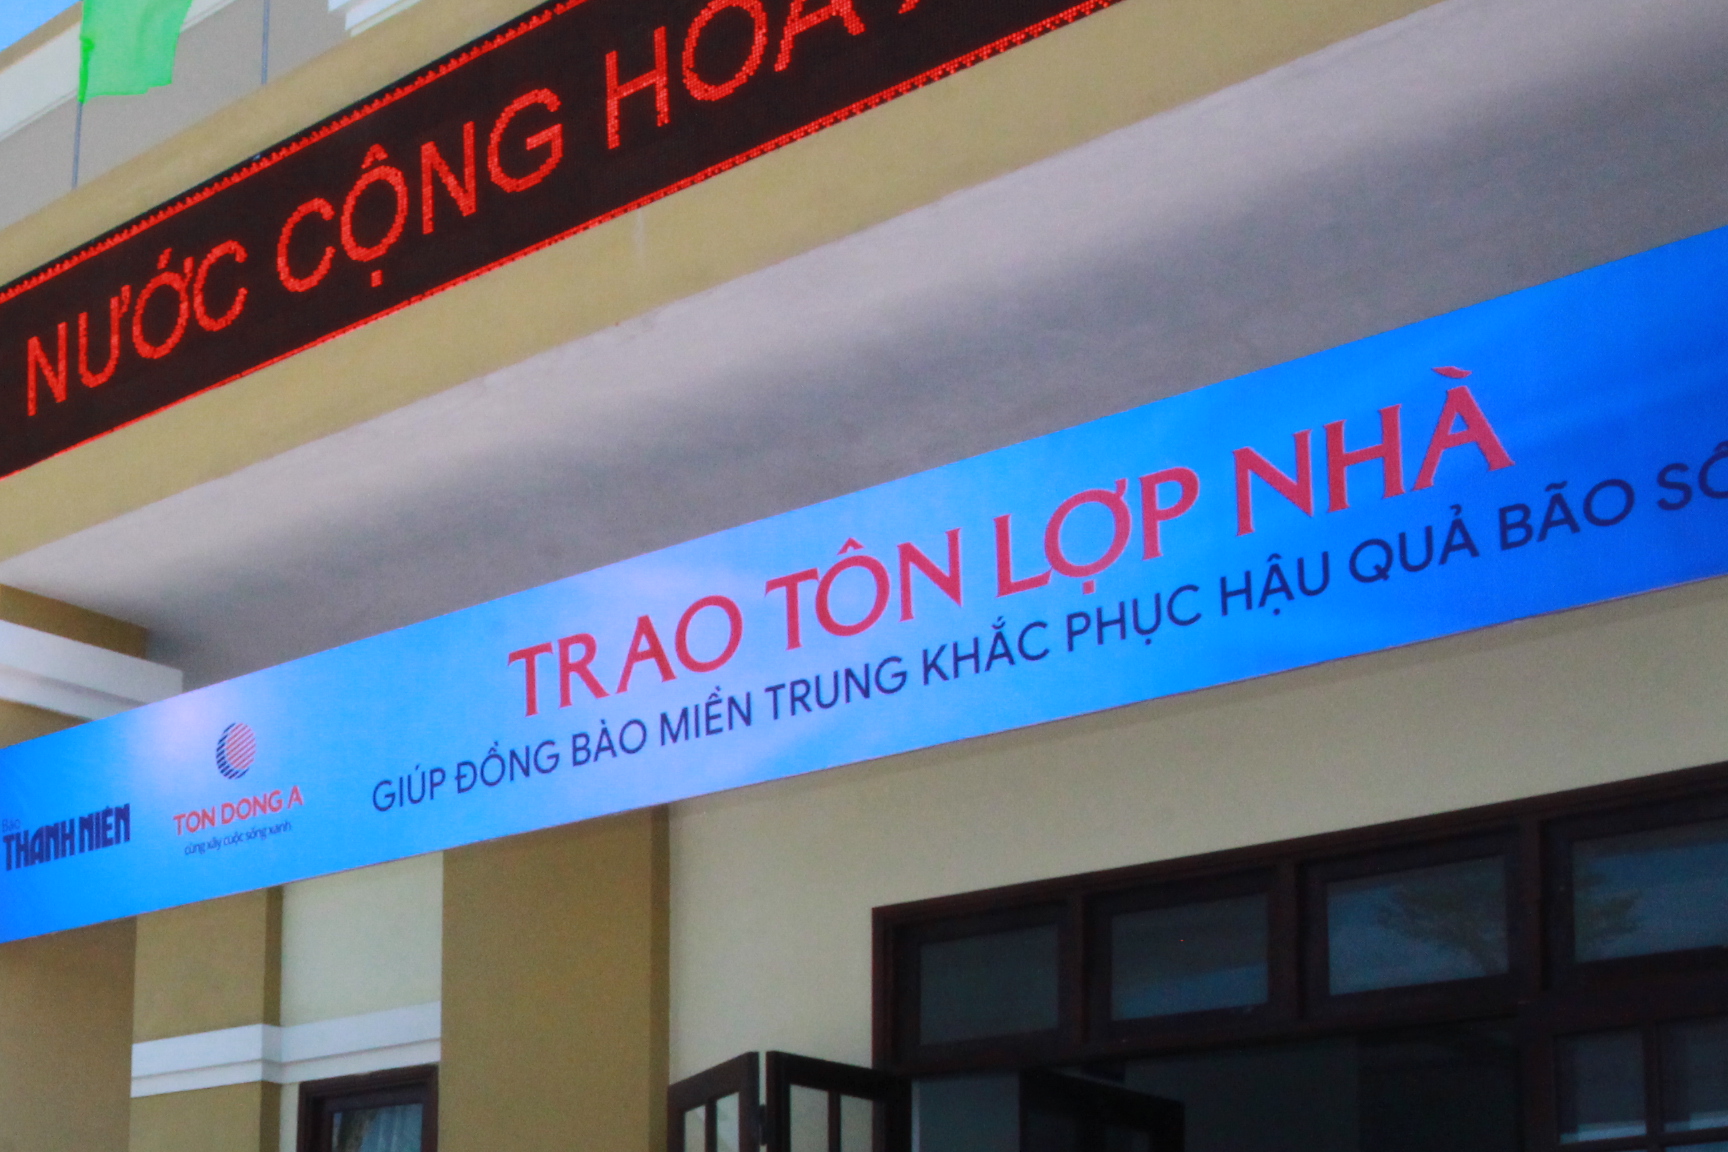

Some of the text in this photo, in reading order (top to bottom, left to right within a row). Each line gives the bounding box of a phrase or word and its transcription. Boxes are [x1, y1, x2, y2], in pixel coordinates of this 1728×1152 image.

[26, 240, 248, 416] NƯỚC
[276, 88, 563, 290] CỘNG
[373, 765, 446, 811] GIÚP
[455, 740, 560, 794] ĐỒNG
[572, 719, 647, 767] BÀO
[659, 686, 752, 746] MIỀN
[765, 655, 908, 720] TRUNG
[922, 616, 1050, 686] KHẮC
[1066, 584, 1202, 653] PHỤC
[1219, 551, 1331, 618] HẬU
[1348, 503, 1480, 584] QUẢ
[1498, 478, 1635, 551] BÃO
[508, 365, 1515, 716] TRAO TÔN LỢP NHÀ
[3, 818, 75, 871] THANH
[173, 785, 304, 836] TON DONG A
